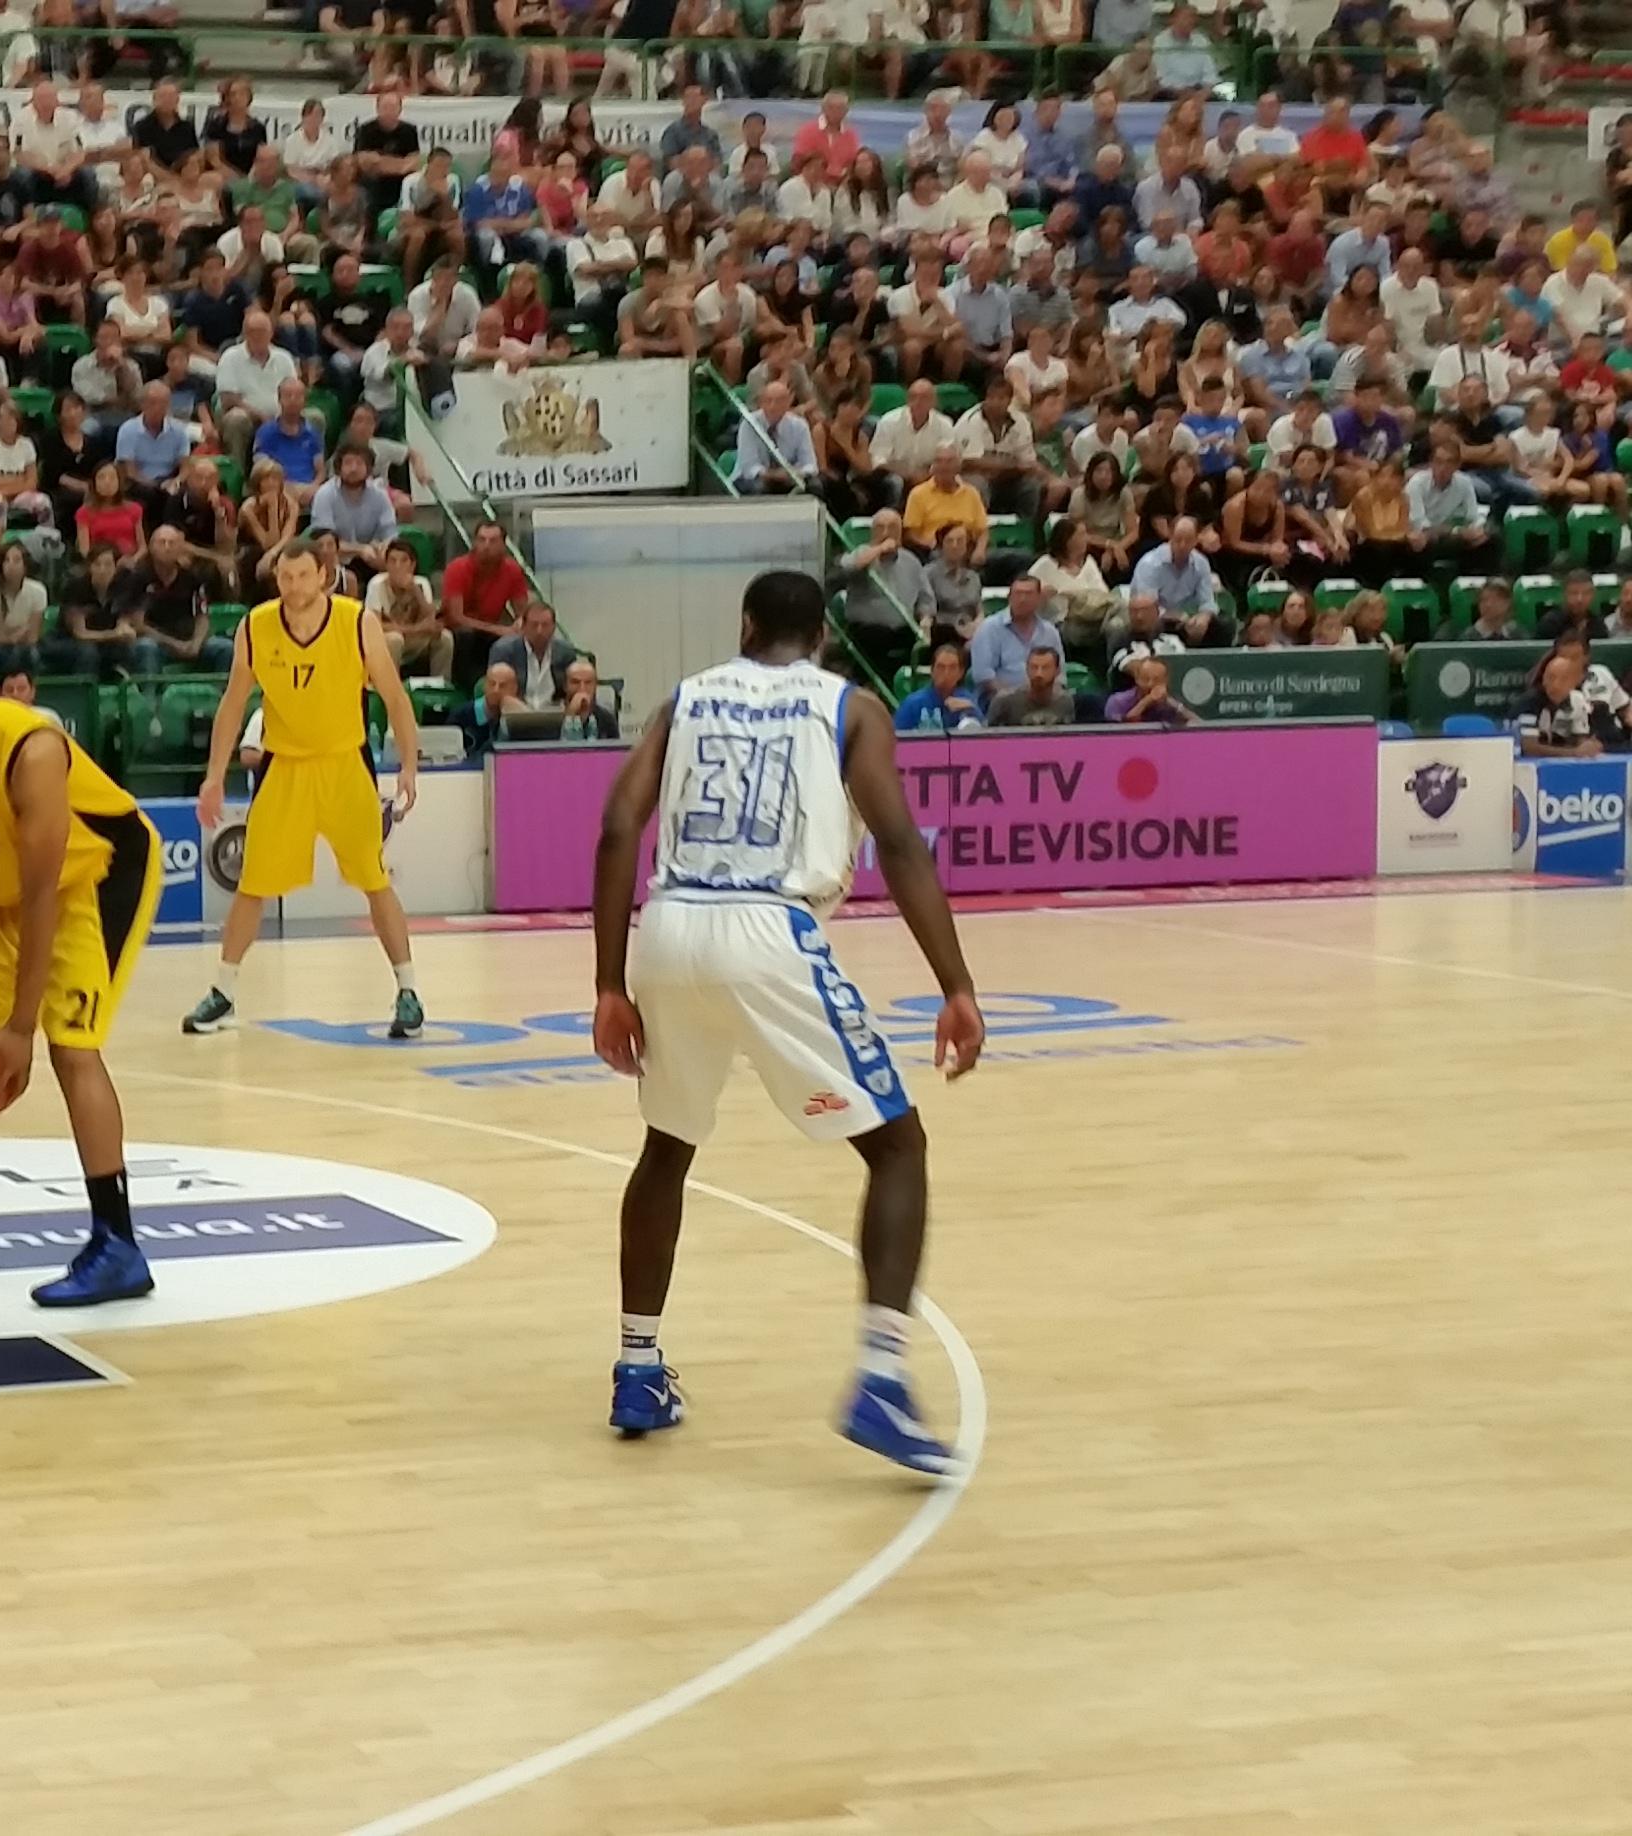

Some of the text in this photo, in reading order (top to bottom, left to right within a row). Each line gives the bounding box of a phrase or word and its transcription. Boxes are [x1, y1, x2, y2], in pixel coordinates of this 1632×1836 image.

[472, 460, 639, 493] Città di Sassari
[293, 664, 316, 690] 17
[1219, 673, 1362, 697] Banco di Sardegna
[681, 733, 795, 847] 31
[898, 760, 1086, 808] TTA TV
[1537, 787, 1624, 825] beko
[66, 988, 100, 1033] 21
